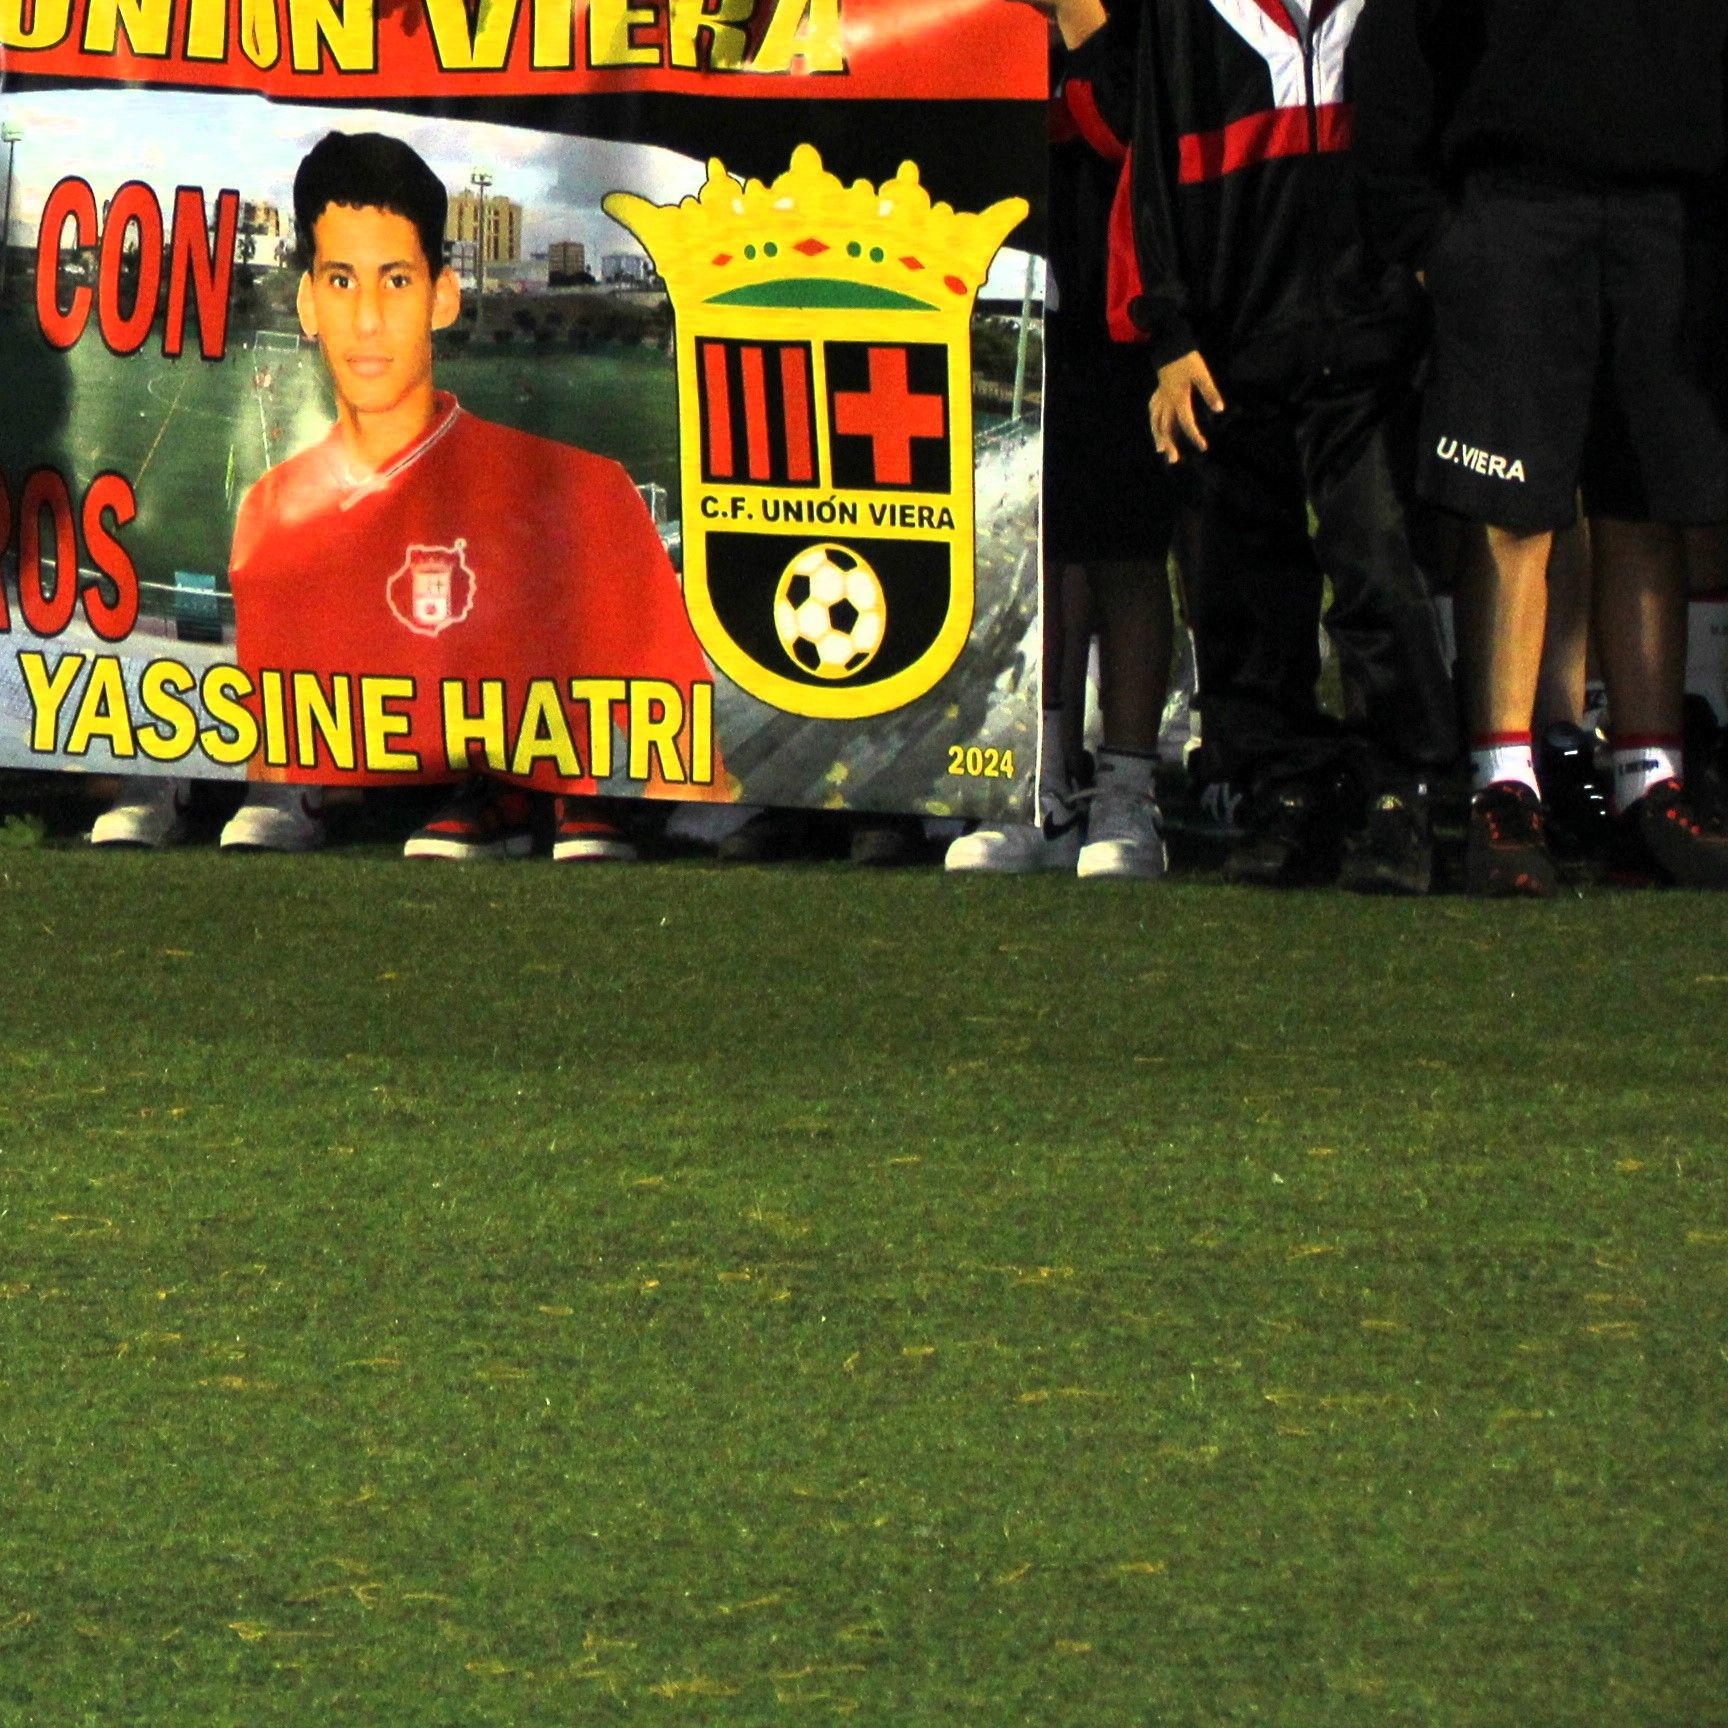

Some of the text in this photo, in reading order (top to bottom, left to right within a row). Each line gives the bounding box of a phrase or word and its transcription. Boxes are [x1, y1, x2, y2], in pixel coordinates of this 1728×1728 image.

[34, 175, 241, 362] CON
[700, 495, 956, 530] C.F. UNIÓN VIERA
[16, 650, 716, 786] YASSINE HATRI
[947, 744, 1015, 779] 2024
